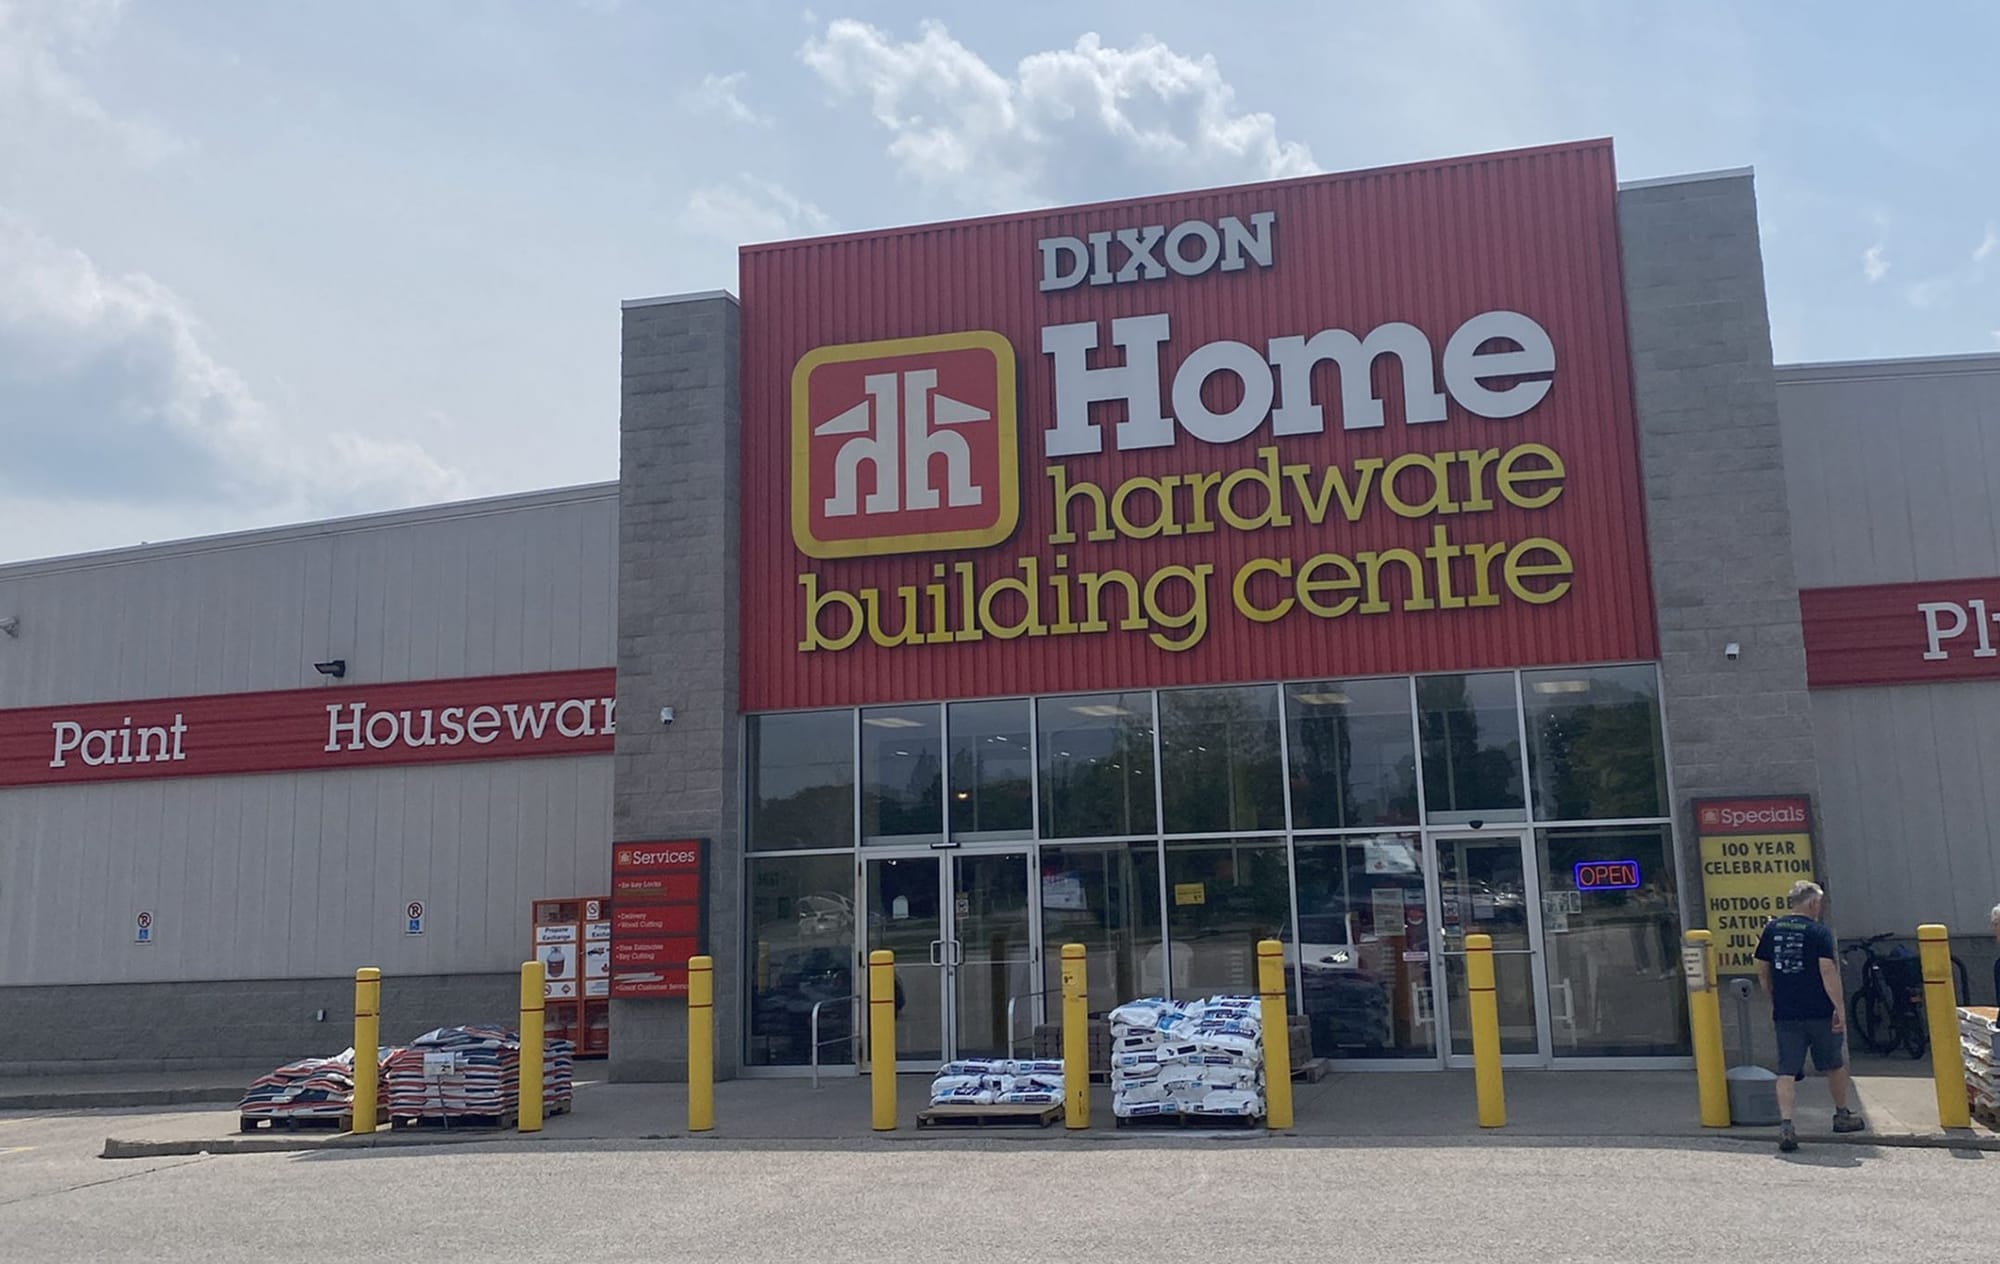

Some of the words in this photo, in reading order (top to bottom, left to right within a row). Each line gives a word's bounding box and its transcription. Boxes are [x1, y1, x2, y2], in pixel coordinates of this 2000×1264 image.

[1038, 211, 1275, 292] DIXON
[1041, 310, 1556, 458] Home
[1046, 442, 1566, 545] hardware
[799, 554, 1214, 652] building
[1233, 524, 1575, 623] centre
[50, 714, 188, 768] Paint
[1721, 806, 1806, 827] Specials
[633, 850, 696, 865] Services
[1722, 842, 1749, 856] 100
[1755, 841, 1796, 855] YEAR
[1580, 865, 1636, 886] OPEN
[1704, 858, 1811, 875] CELEBRATION
[1710, 896, 1770, 911] HOTDOG
[1719, 914, 1777, 929] SATUR
